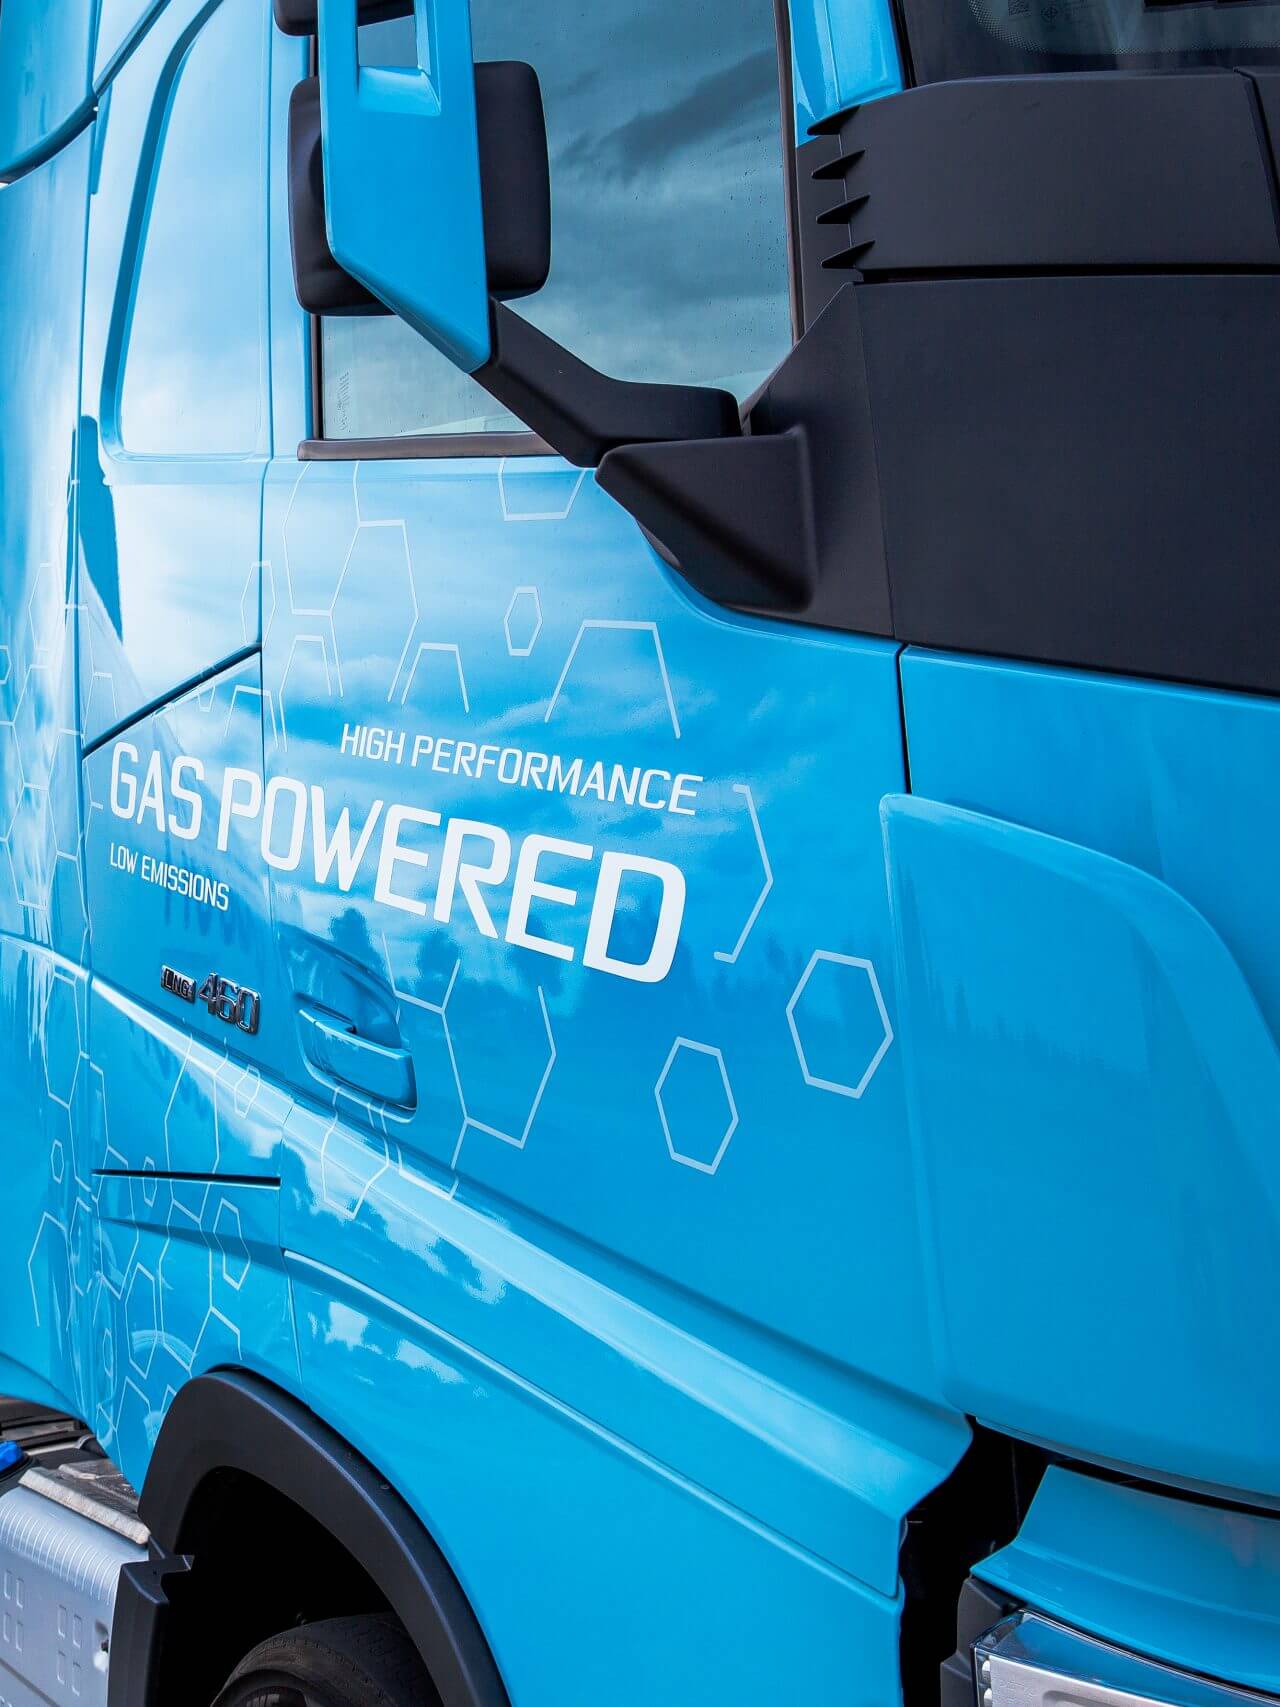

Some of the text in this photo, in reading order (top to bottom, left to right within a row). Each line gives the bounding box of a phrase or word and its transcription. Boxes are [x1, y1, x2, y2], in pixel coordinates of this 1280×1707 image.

[340, 723, 704, 816] HIGH PERFORMANCE
[110, 741, 687, 984] GAS POWERED
[110, 842, 230, 911] LOW EMISSIONS
[163, 966, 261, 1035] LNG 460
